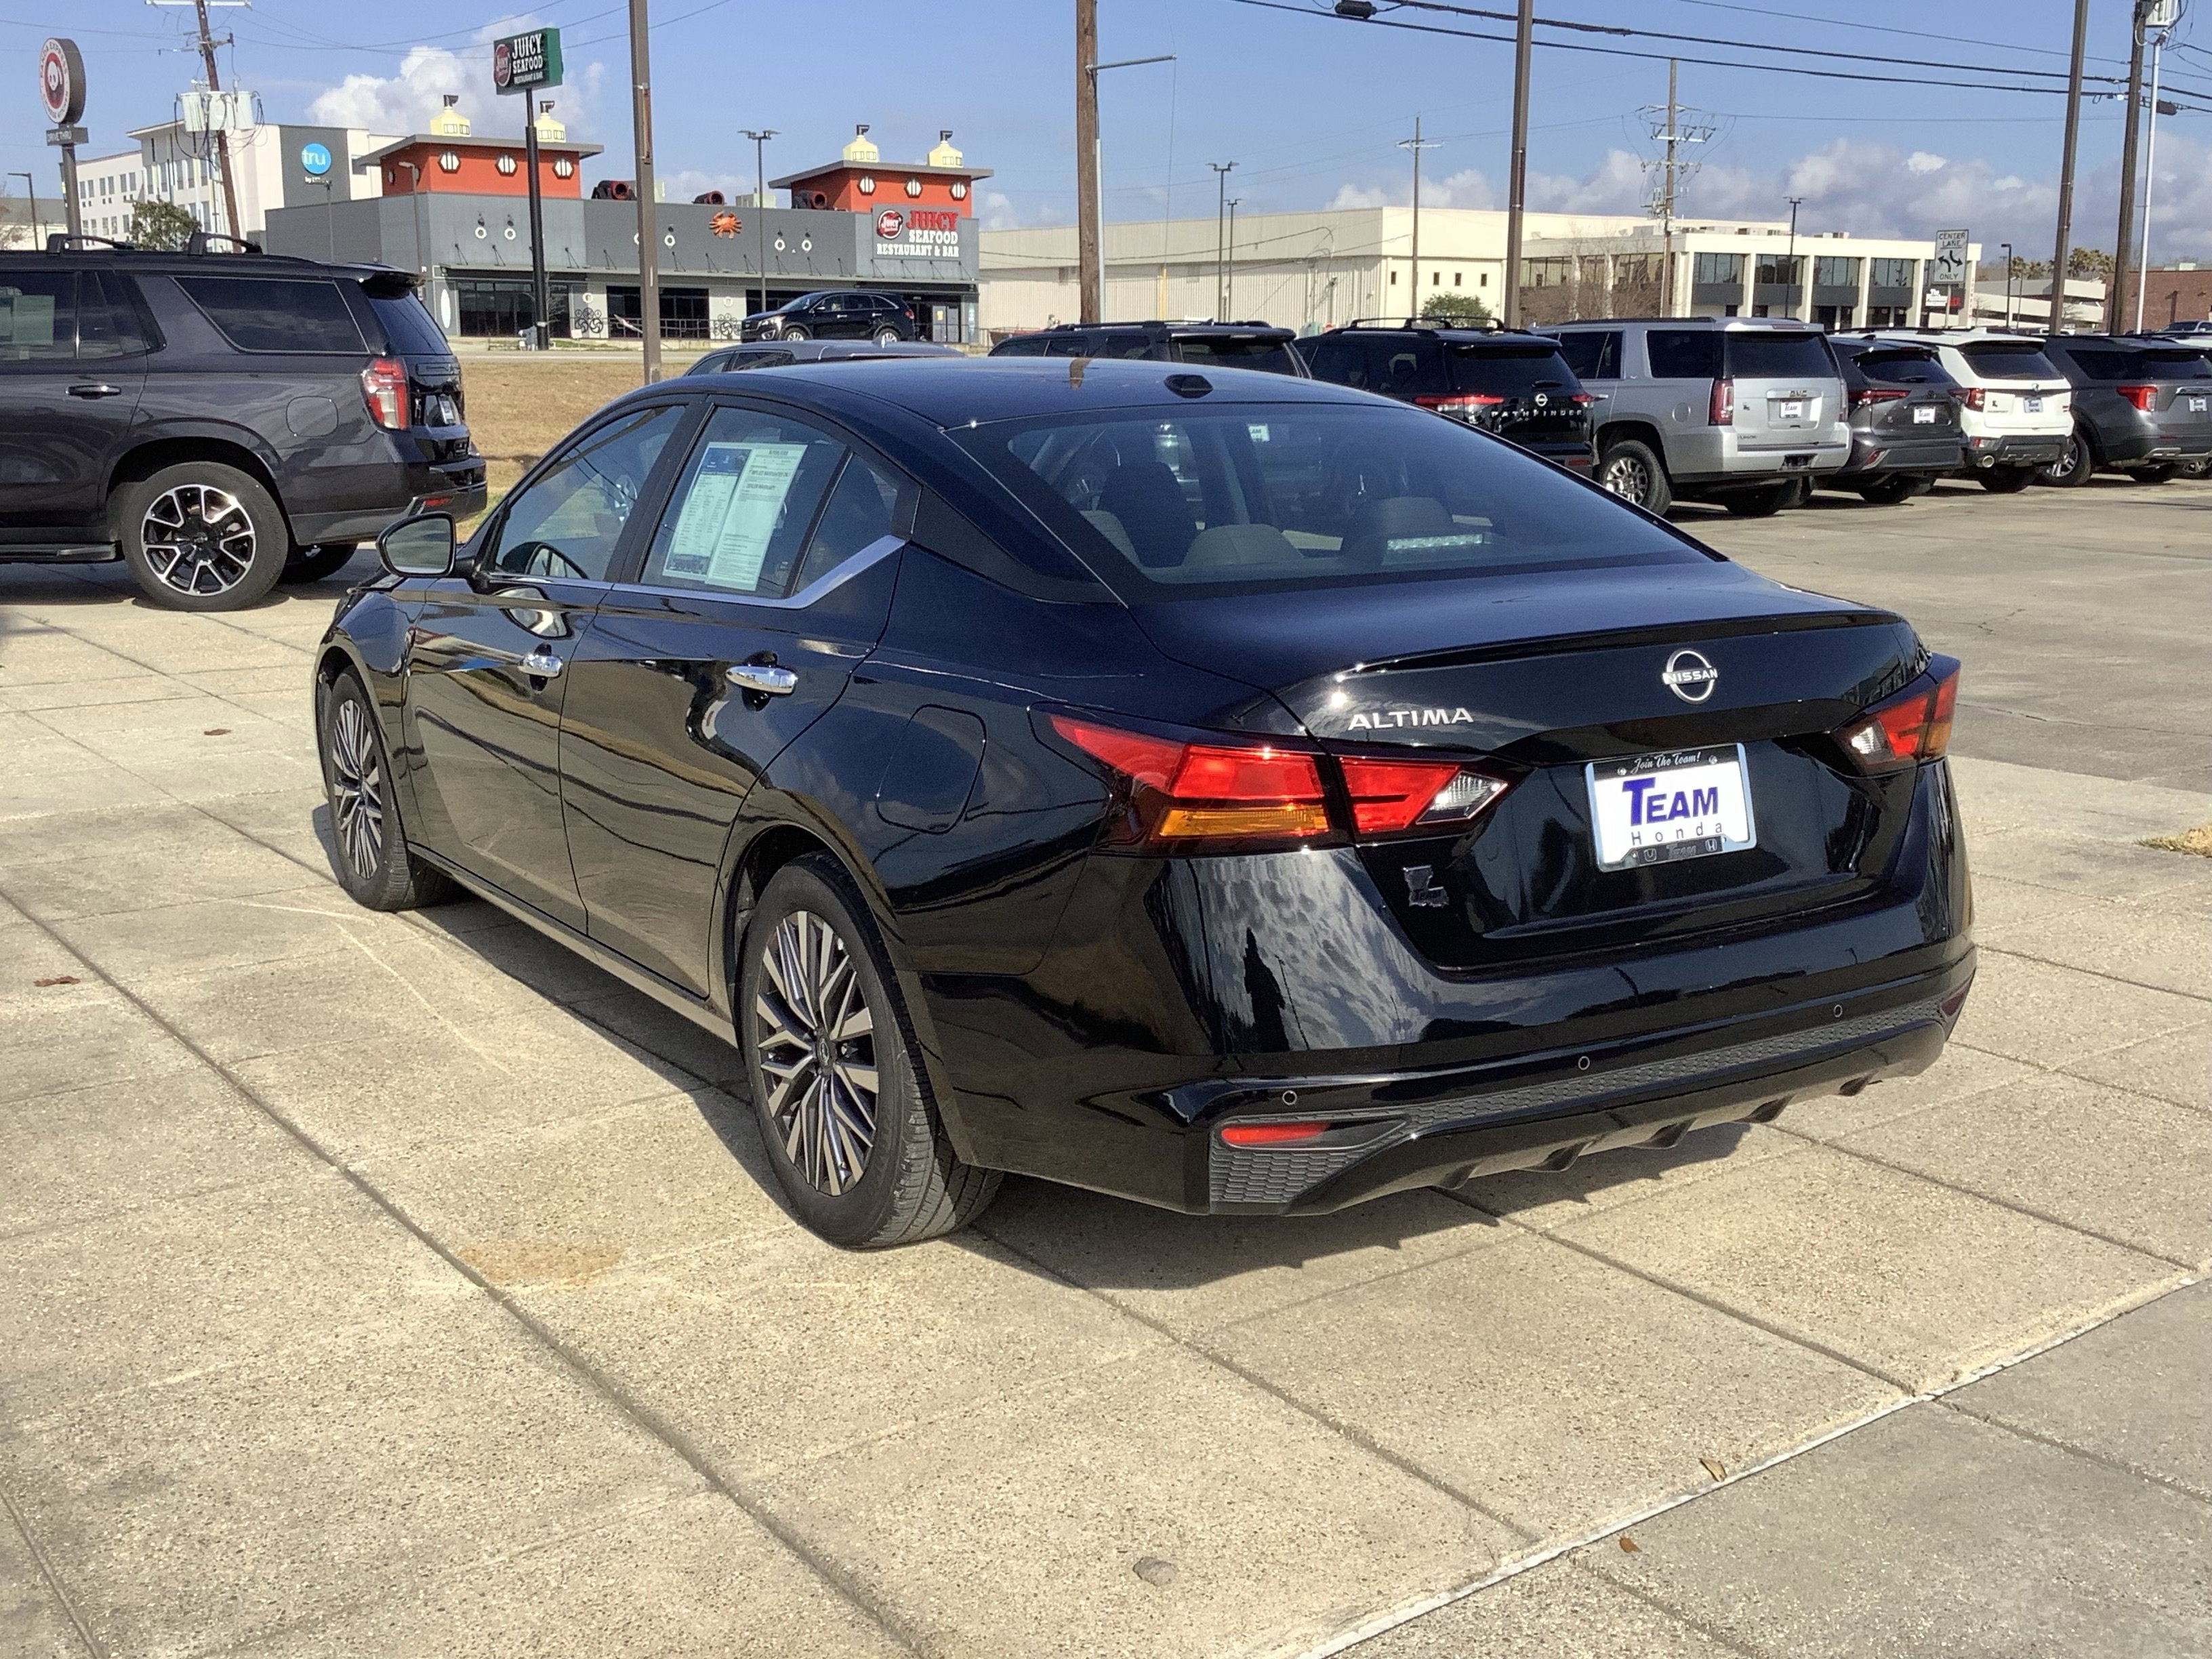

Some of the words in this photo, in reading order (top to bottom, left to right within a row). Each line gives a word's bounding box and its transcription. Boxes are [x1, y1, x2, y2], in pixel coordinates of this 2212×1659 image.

[512, 33, 541, 59] JUICY
[512, 55, 543, 75] SEAFOOD
[302, 148, 326, 165] tru
[906, 210, 958, 231] JUICY
[909, 230, 958, 244] SEAFOOD
[877, 243, 932, 256] RESTAURANT
[935, 245, 941, 256] &
[942, 246, 959, 258] BAR
[1491, 409, 1582, 417] PATHFINDER
[1664, 669, 1718, 684] NISSAN
[1347, 708, 1474, 731] ALTIMA
[1631, 757, 1654, 774] Join
[1654, 754, 1672, 768] The
[1673, 752, 1702, 764] Team!
[1622, 777, 1719, 827] TEAM
[1631, 821, 1723, 846] Honda
